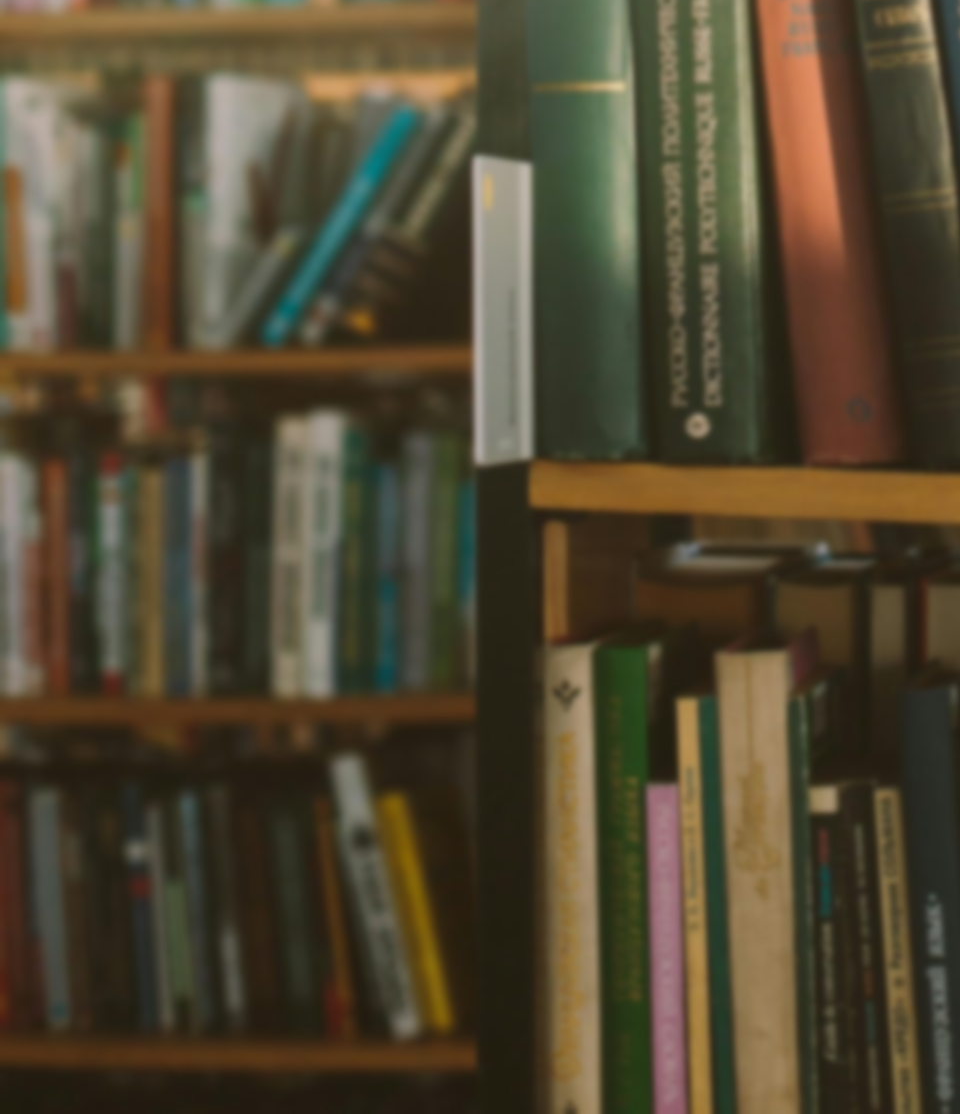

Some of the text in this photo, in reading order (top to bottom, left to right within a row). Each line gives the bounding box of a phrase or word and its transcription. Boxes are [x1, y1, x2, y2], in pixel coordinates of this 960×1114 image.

[695, 91, 720, 255] POLYTECHNIQUE
[661, 161, 689, 408] РУССКО-ФРАНЦУЗСКИЙ
[699, 262, 723, 407] DICTIONNAIRE
[556, 729, 579, 892] СТИЛИСТИКА
[924, 901, 955, 1103] ФРАНЦУЗСКИЙ ЯЗЫК
